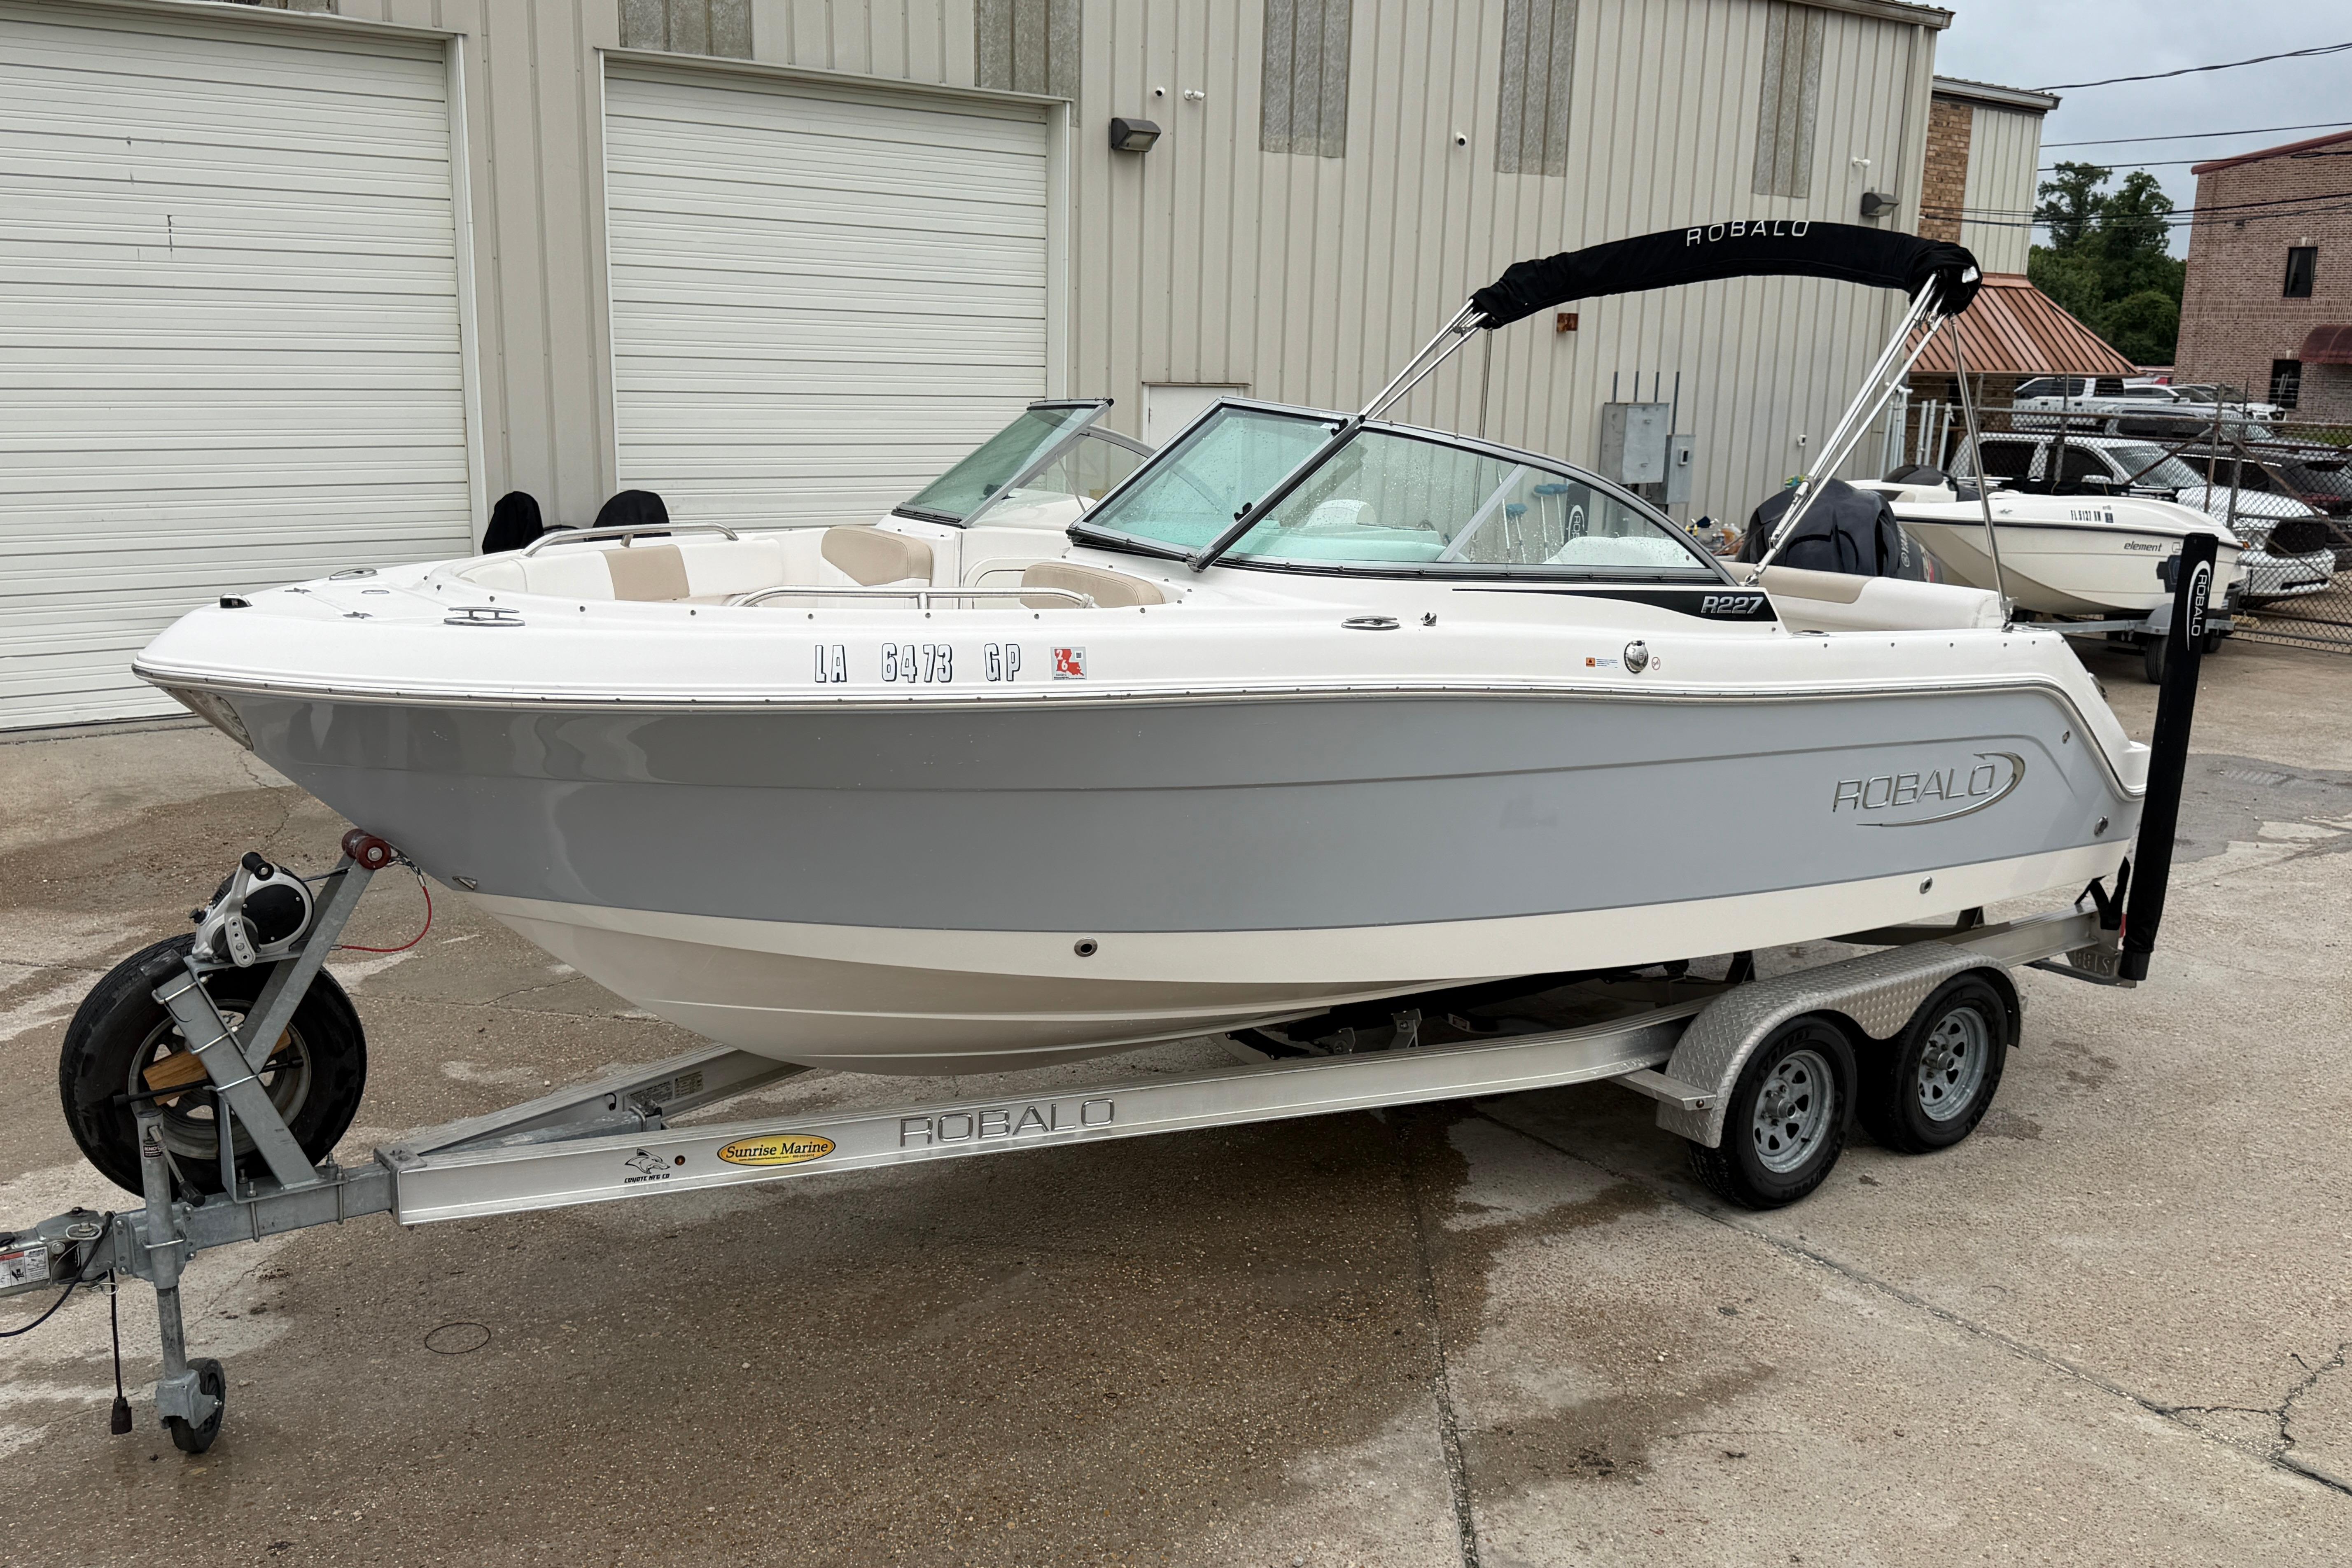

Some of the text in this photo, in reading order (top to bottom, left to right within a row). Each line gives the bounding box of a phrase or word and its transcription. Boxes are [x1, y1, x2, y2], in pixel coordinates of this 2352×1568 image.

[1687, 220, 1810, 247] ROBALO
[2124, 541, 2162, 552] element
[1701, 596, 1764, 614] R227
[2191, 574, 2207, 636] ROBALO
[815, 643, 1021, 683] LA 6473 GP
[1832, 763, 1995, 812] ROBALO
[900, 1098, 1115, 1147] ROBALO
[726, 1144, 777, 1158] Sunrise
[780, 1141, 828, 1155] Marine
